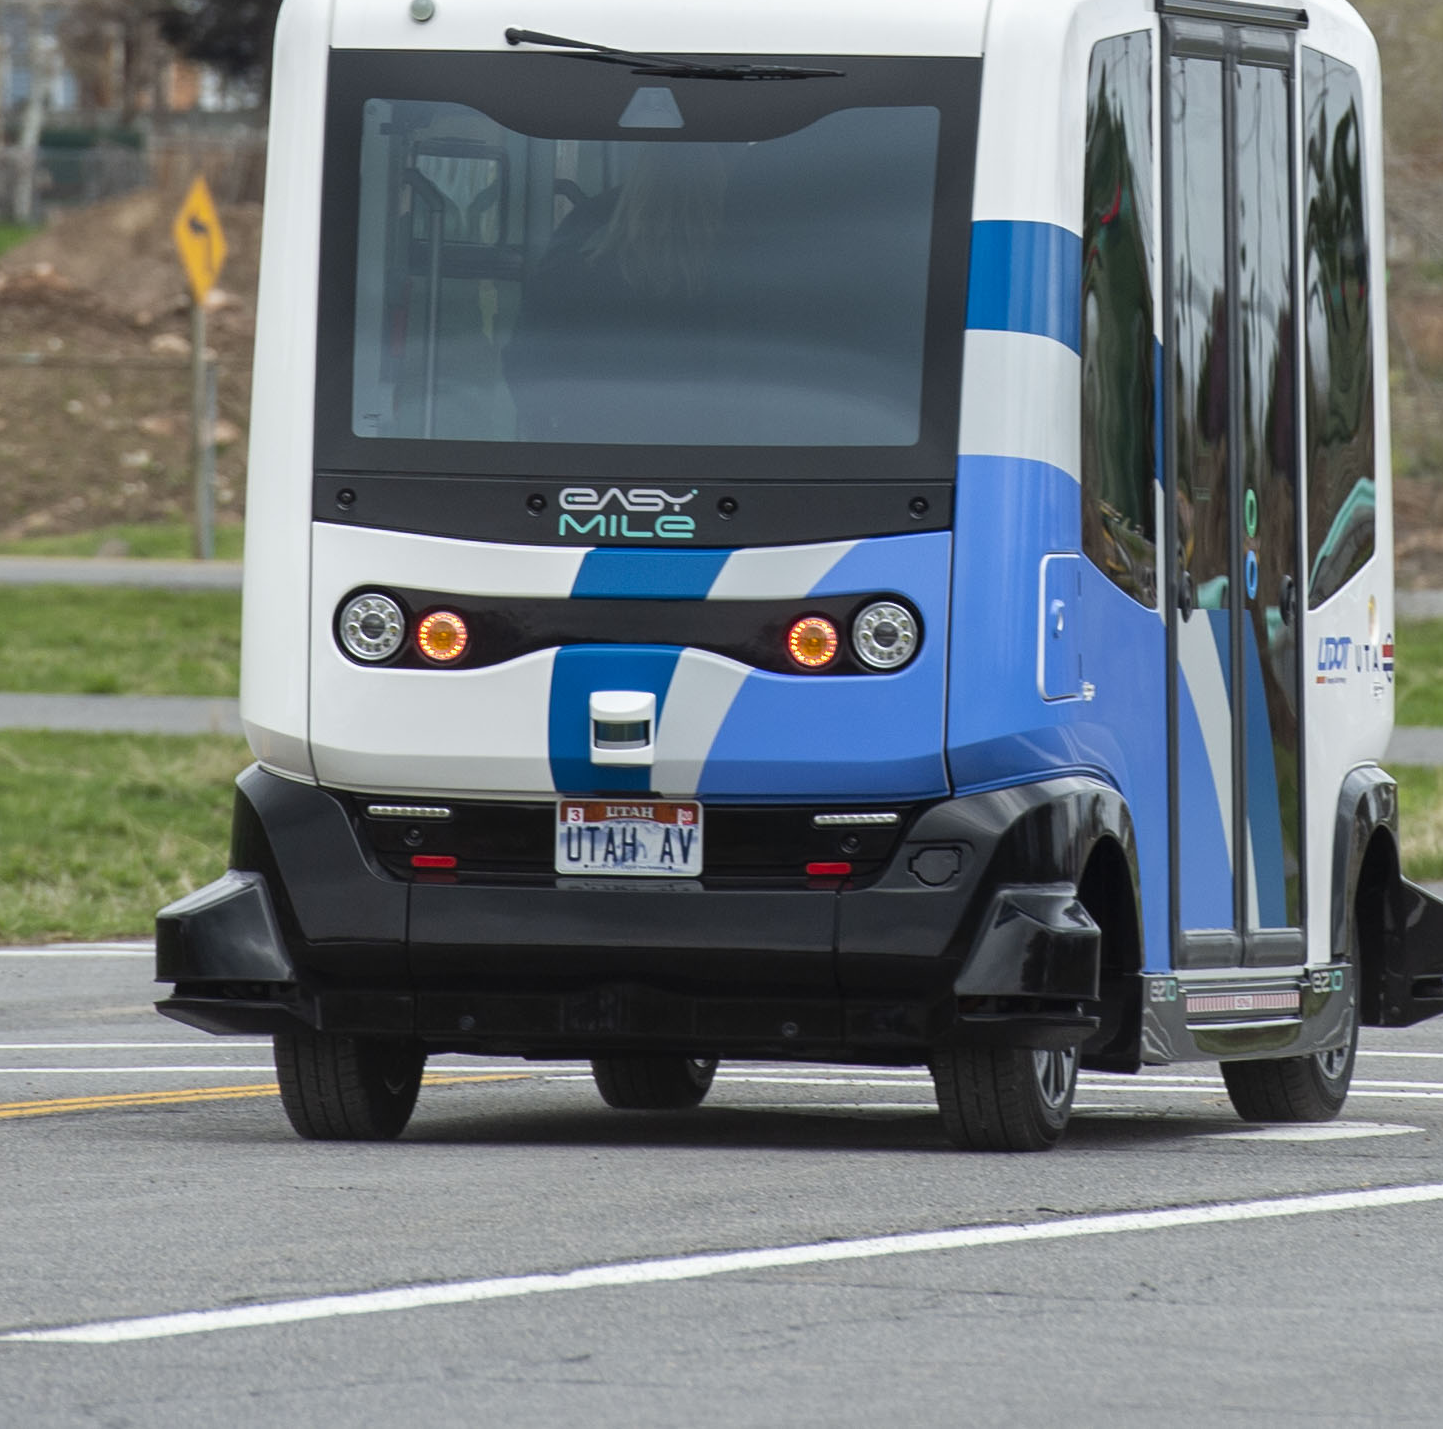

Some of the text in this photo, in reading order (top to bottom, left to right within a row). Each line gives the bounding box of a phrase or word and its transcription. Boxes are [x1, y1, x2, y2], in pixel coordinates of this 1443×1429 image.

[570, 809, 581, 822] 3
[605, 806, 655, 819] UTAH
[566, 826, 694, 864] UTAH AV
